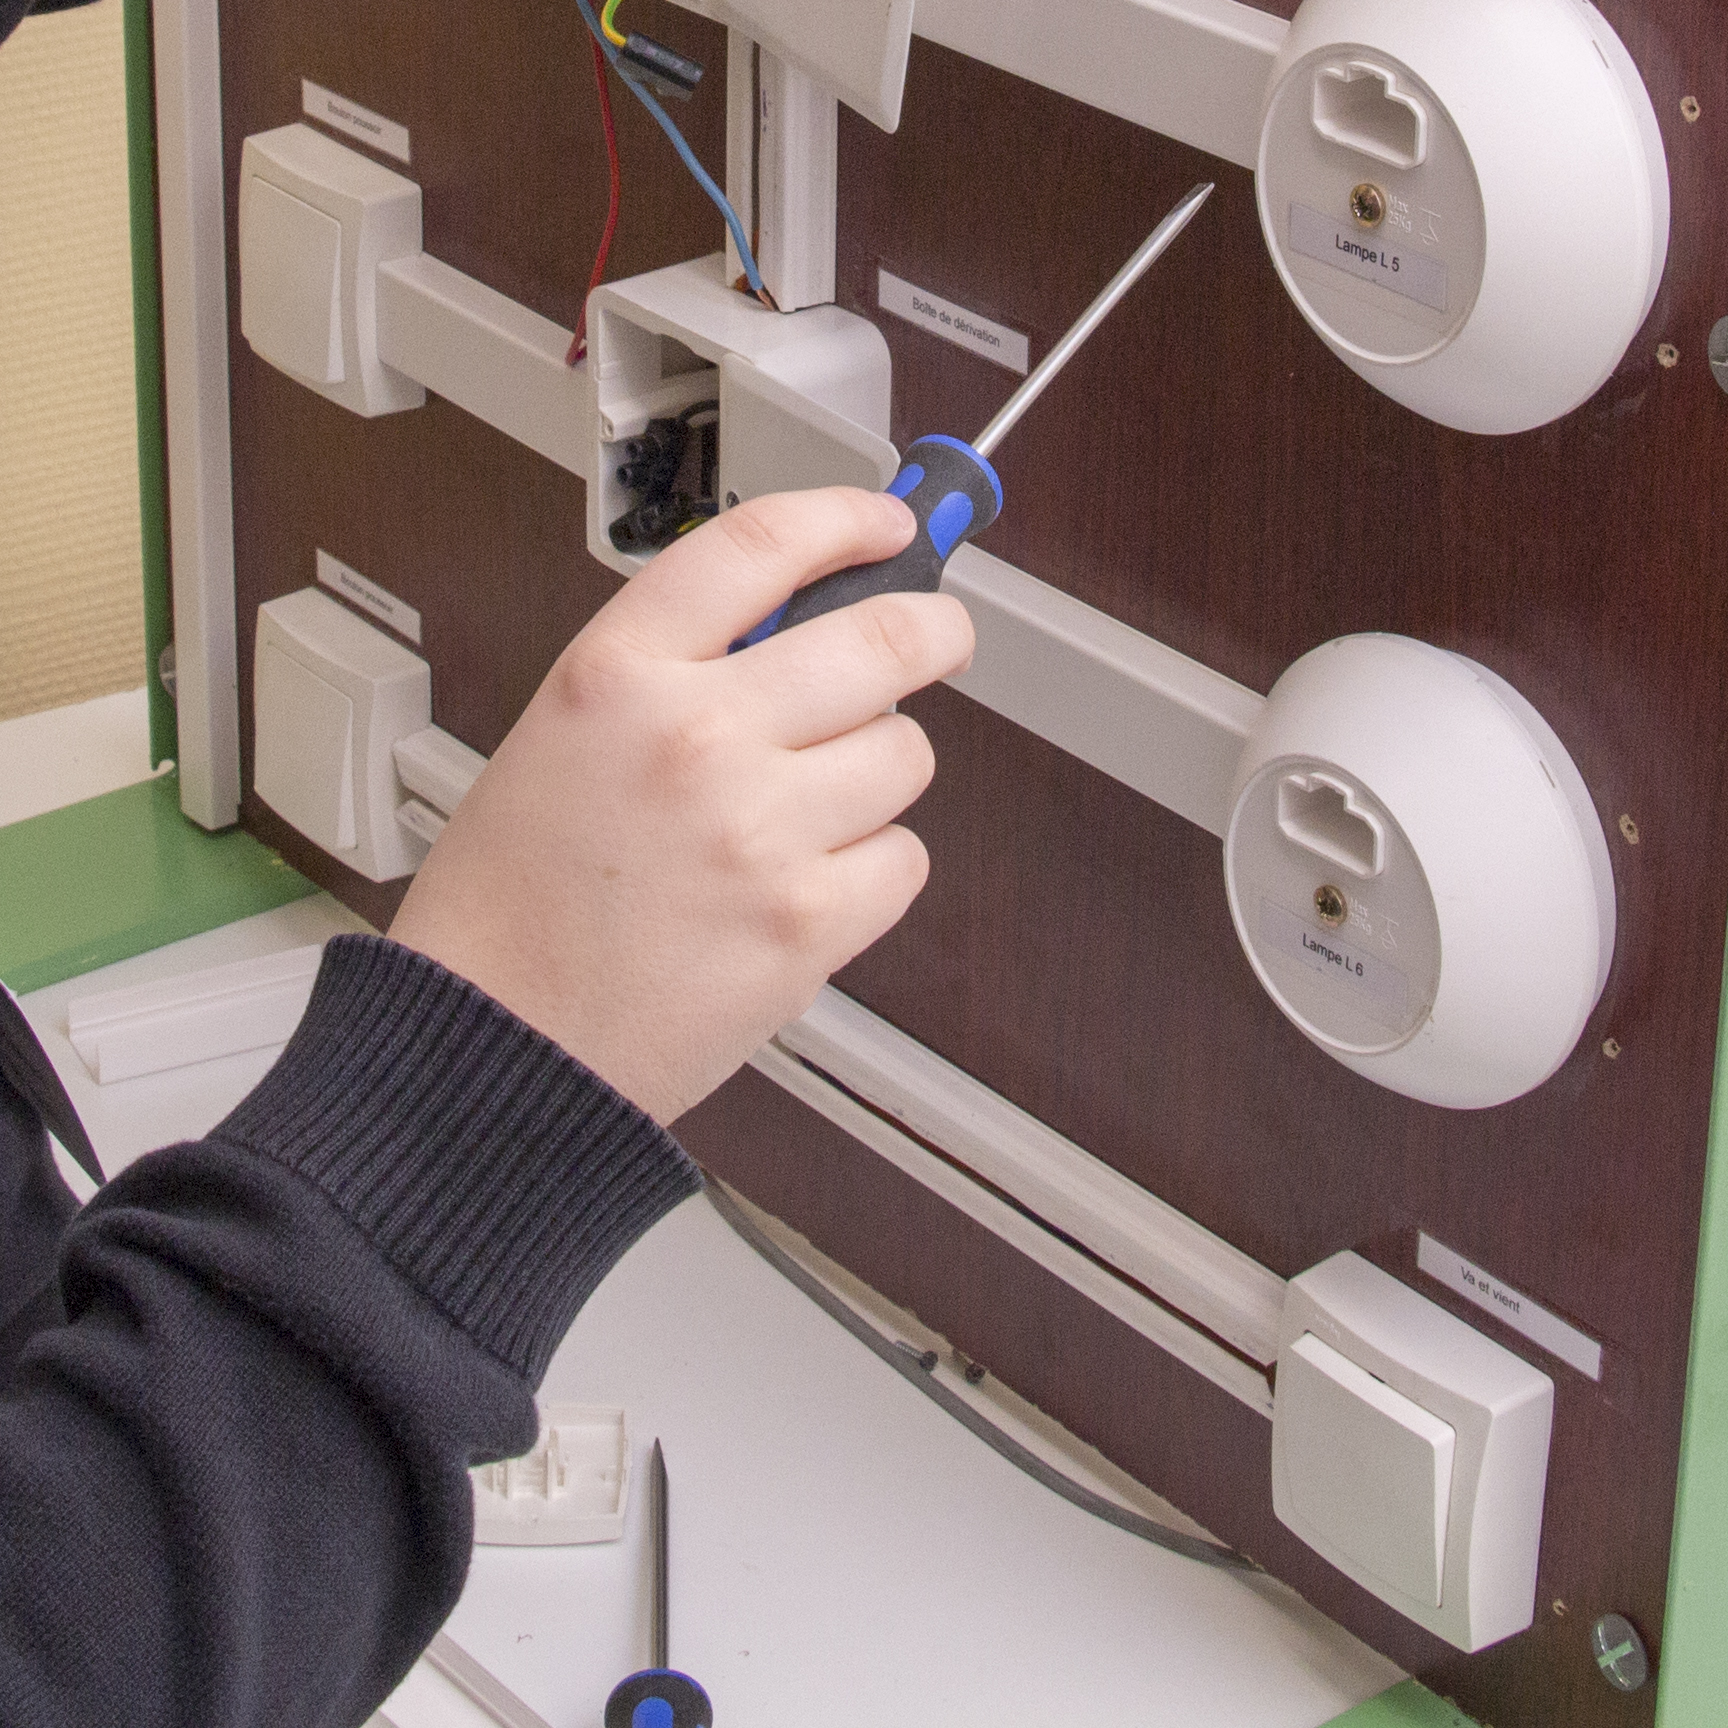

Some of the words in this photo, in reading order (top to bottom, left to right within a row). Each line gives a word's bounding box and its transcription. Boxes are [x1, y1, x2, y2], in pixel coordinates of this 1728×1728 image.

[1335, 234, 1377, 263] Lampe
[1380, 252, 1389, 268] L
[1391, 256, 1400, 272] 5
[938, 310, 952, 325] de
[953, 316, 1000, 348] dérivation
[1302, 932, 1343, 965] Lampe
[1345, 955, 1353, 972] L
[1355, 962, 1364, 977] 6
[1460, 1265, 1475, 1286] Va
[1478, 1280, 1490, 1295] et
[1493, 1289, 1520, 1314] vient
